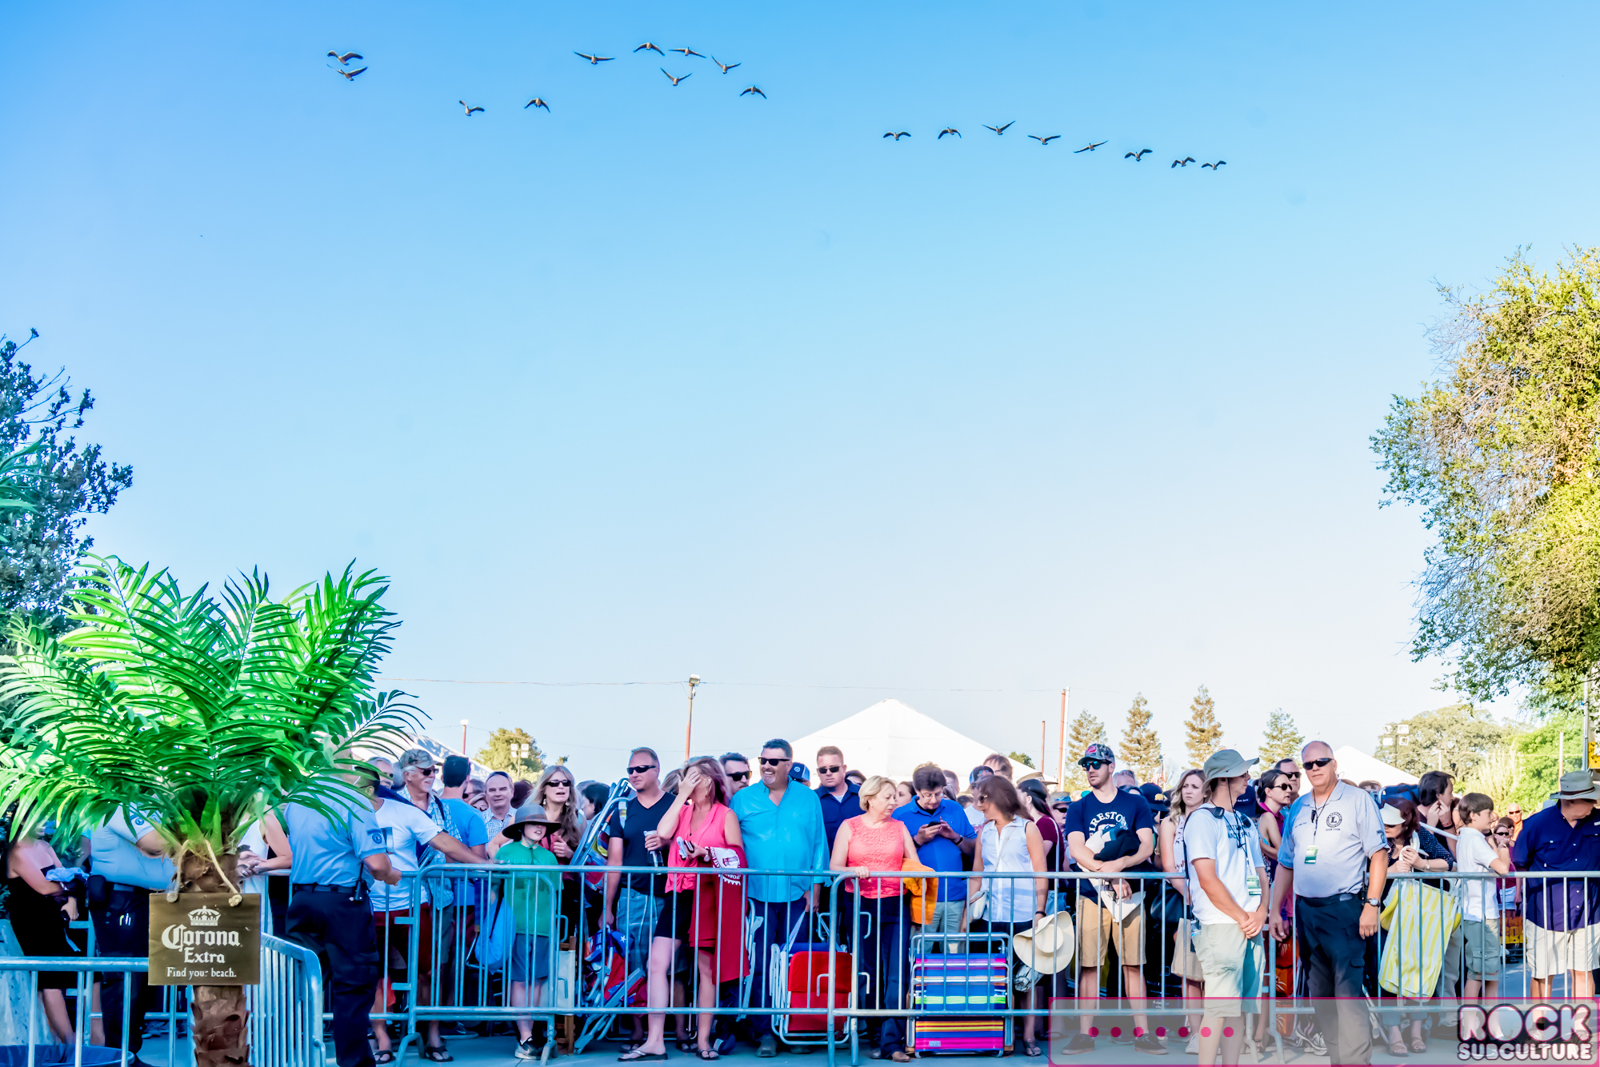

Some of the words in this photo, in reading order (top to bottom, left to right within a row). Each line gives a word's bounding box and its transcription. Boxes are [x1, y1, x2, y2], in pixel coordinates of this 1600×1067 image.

[161, 924, 240, 952] Corona
[184, 947, 225, 963] Extra
[166, 966, 187, 977] Find
[211, 967, 237, 978] beach.
